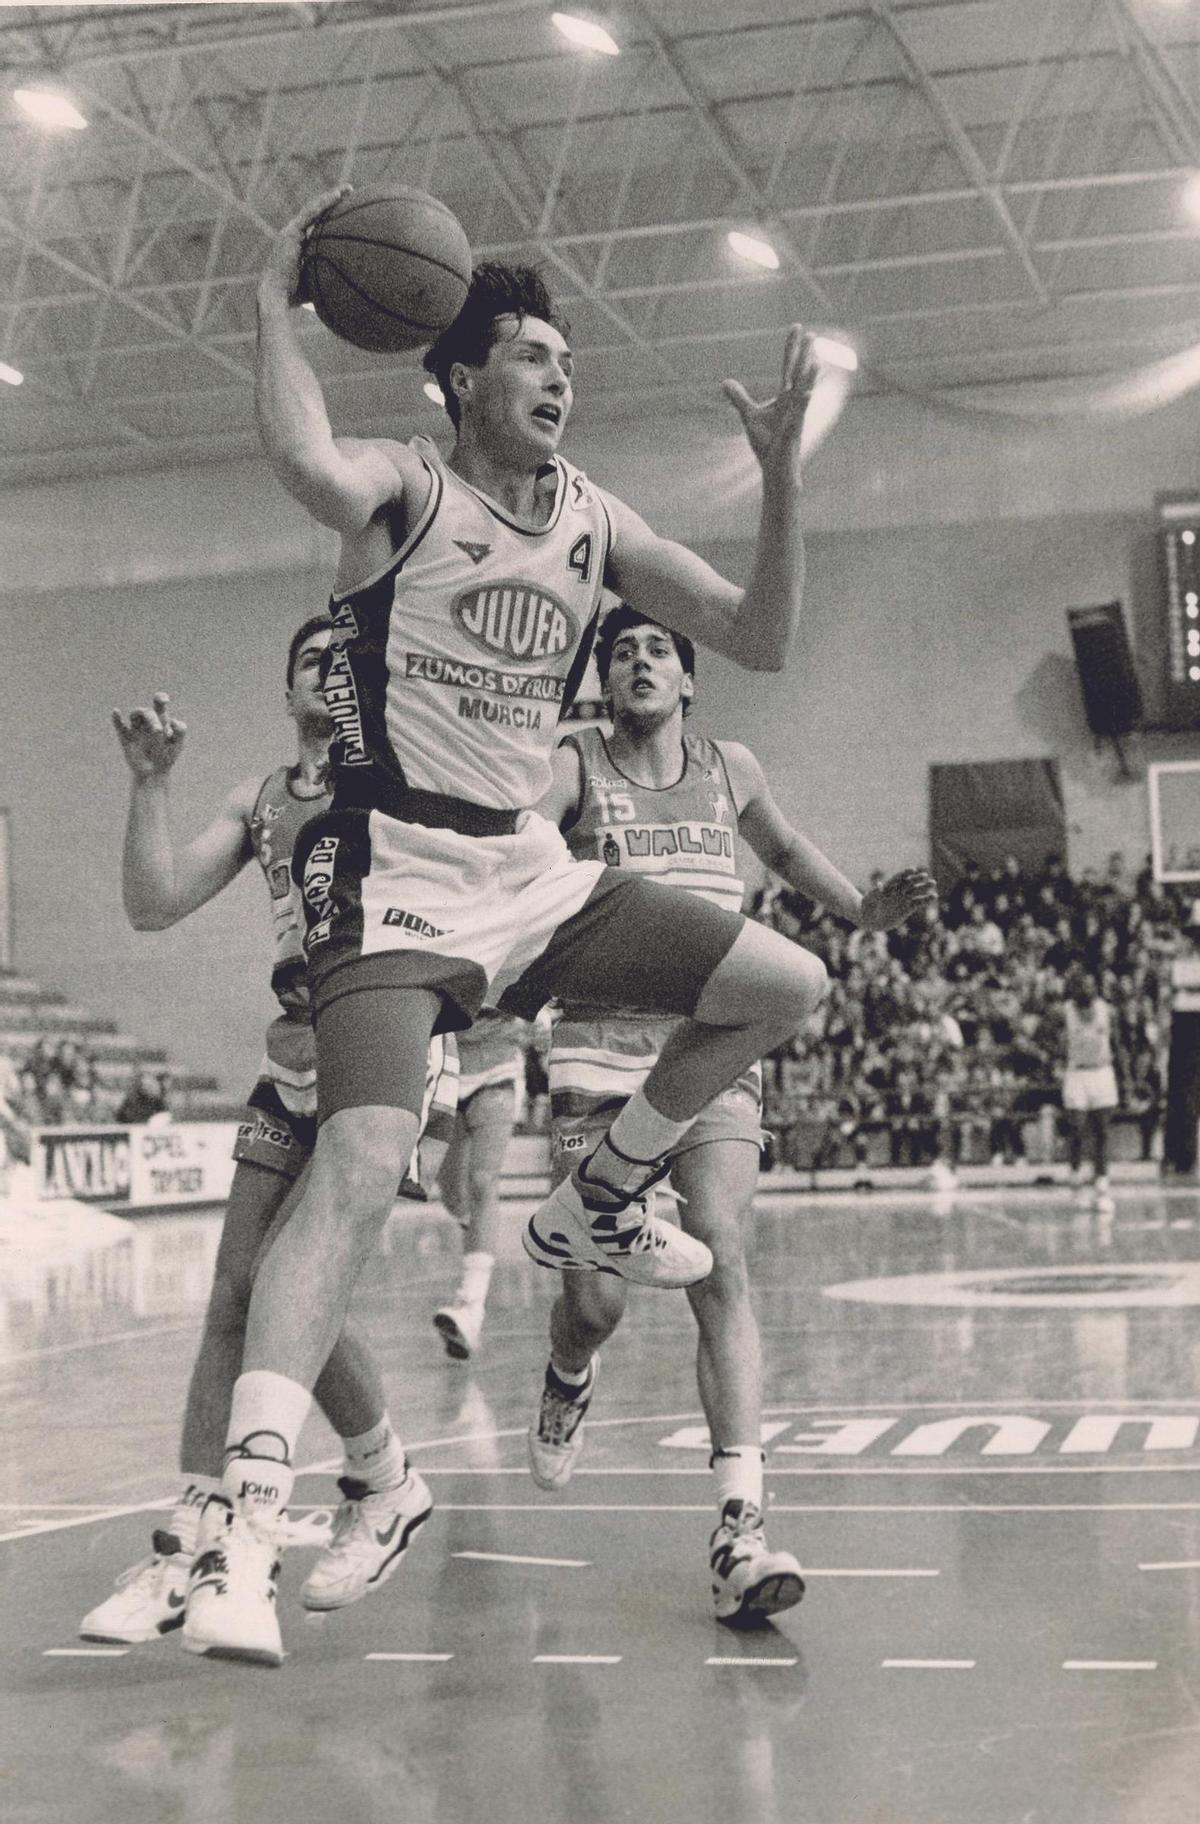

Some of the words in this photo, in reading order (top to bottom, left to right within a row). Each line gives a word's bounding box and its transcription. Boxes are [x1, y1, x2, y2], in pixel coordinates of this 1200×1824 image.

[568, 531, 593, 584] 4
[462, 589, 568, 658] JUVER
[408, 656, 497, 691] ZUMOS
[458, 696, 541, 730] MURCIA
[596, 789, 636, 823] 15
[624, 826, 732, 859] VALVI
